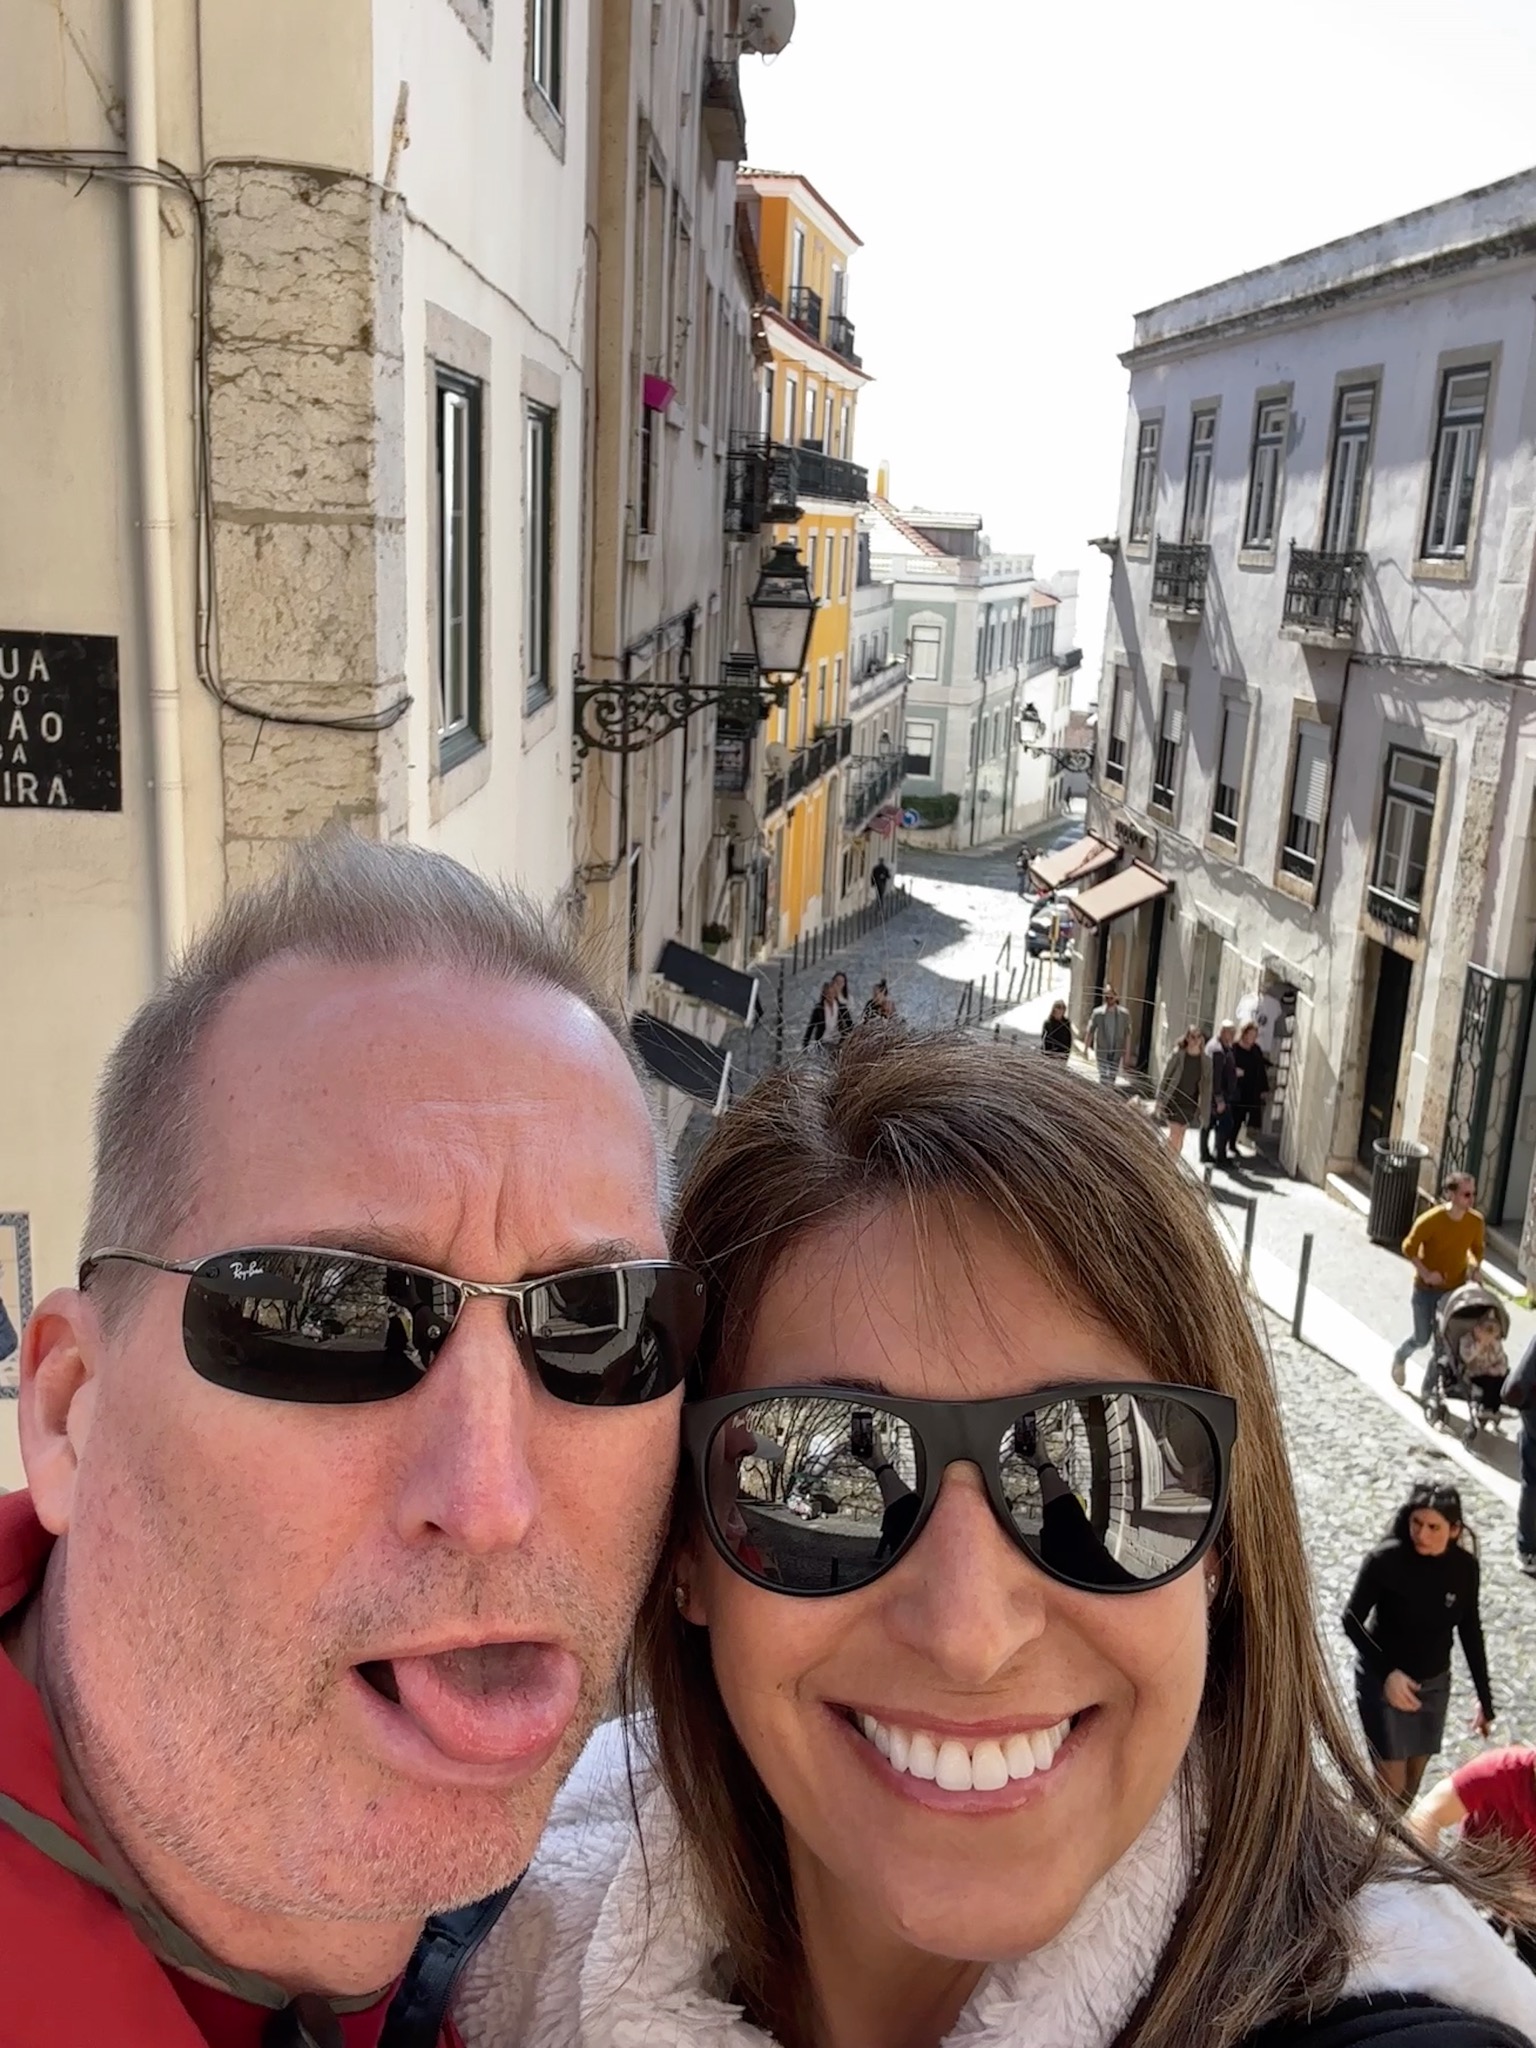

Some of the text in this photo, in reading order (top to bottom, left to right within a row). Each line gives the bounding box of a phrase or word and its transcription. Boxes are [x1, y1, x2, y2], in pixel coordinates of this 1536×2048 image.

[0, 647, 50, 682] UA
[0, 684, 30, 706] O
[0, 743, 27, 764] A
[3, 770, 68, 806] IRA
